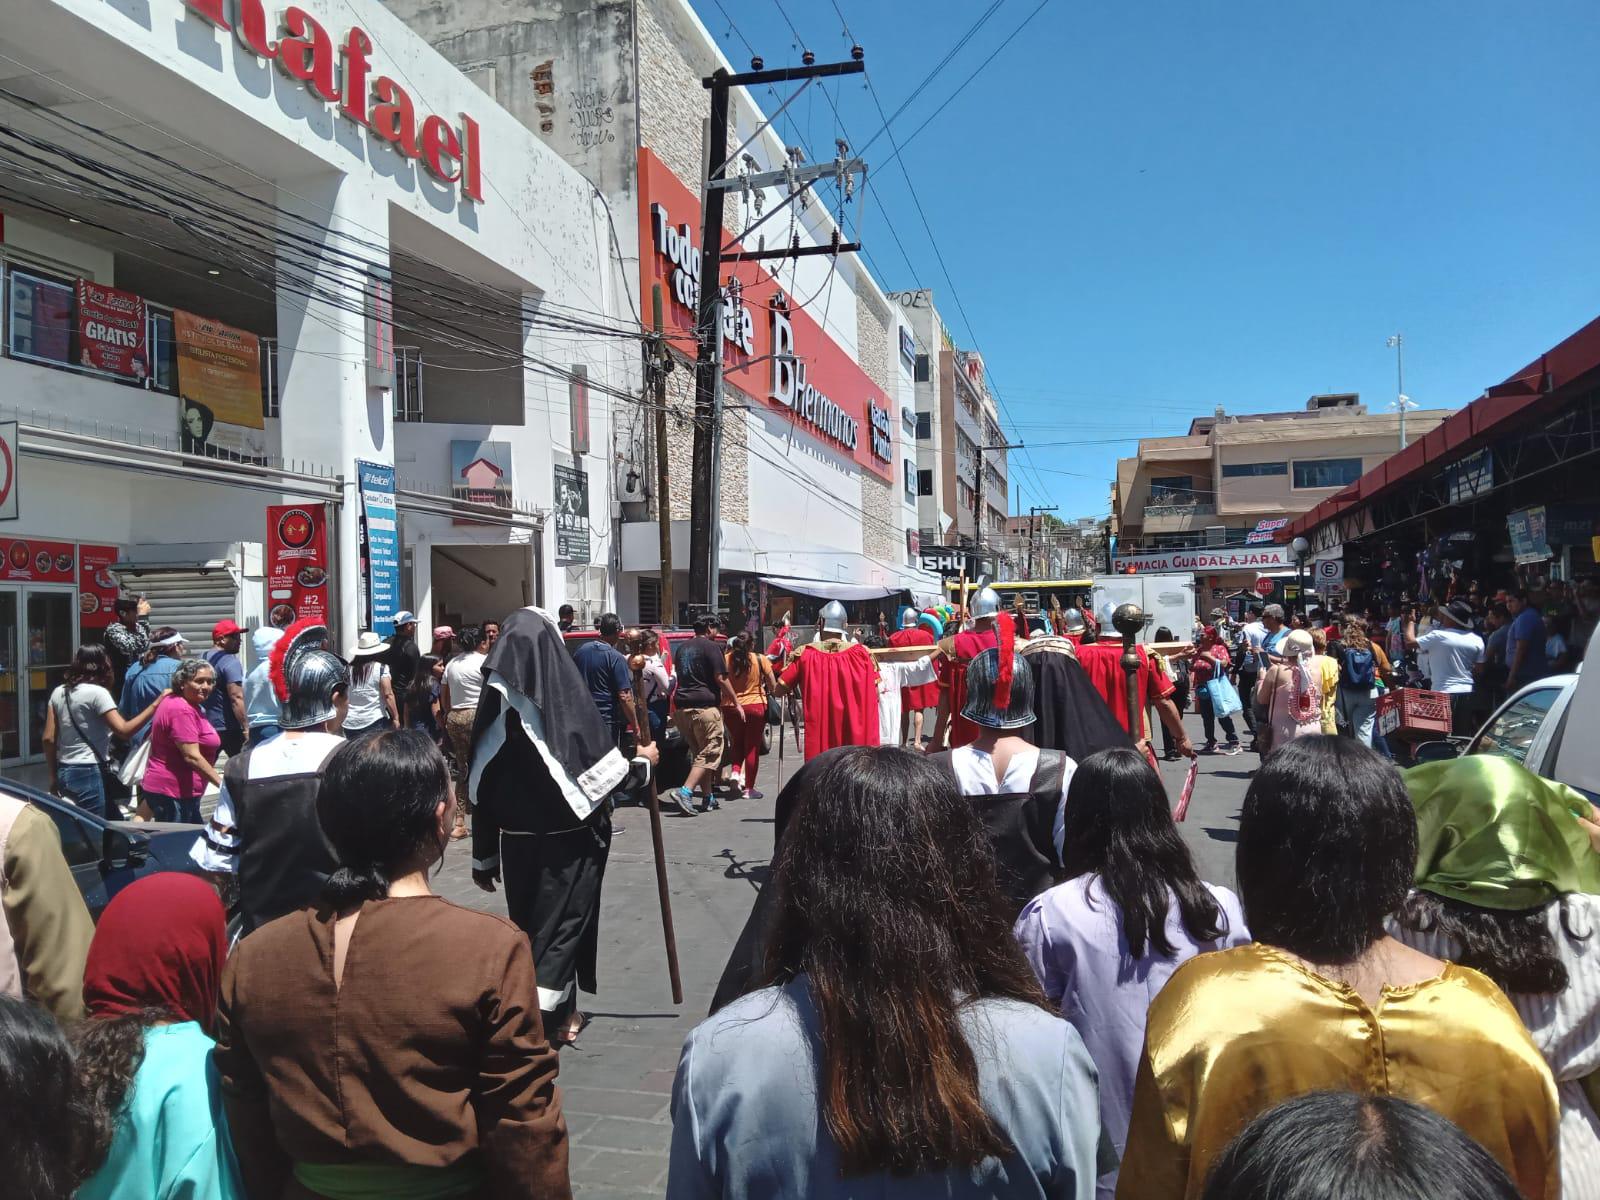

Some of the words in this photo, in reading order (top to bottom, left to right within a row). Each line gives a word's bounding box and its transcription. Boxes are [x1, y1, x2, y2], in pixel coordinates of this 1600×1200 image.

[85, 321, 137, 348] GRATIS
[1257, 518, 1287, 532] Super
[1247, 531, 1273, 544] Farm
[1172, 553, 1281, 568] GUADALAJARA
[1325, 564, 1333, 574] E
[304, 595, 319, 605] #2
